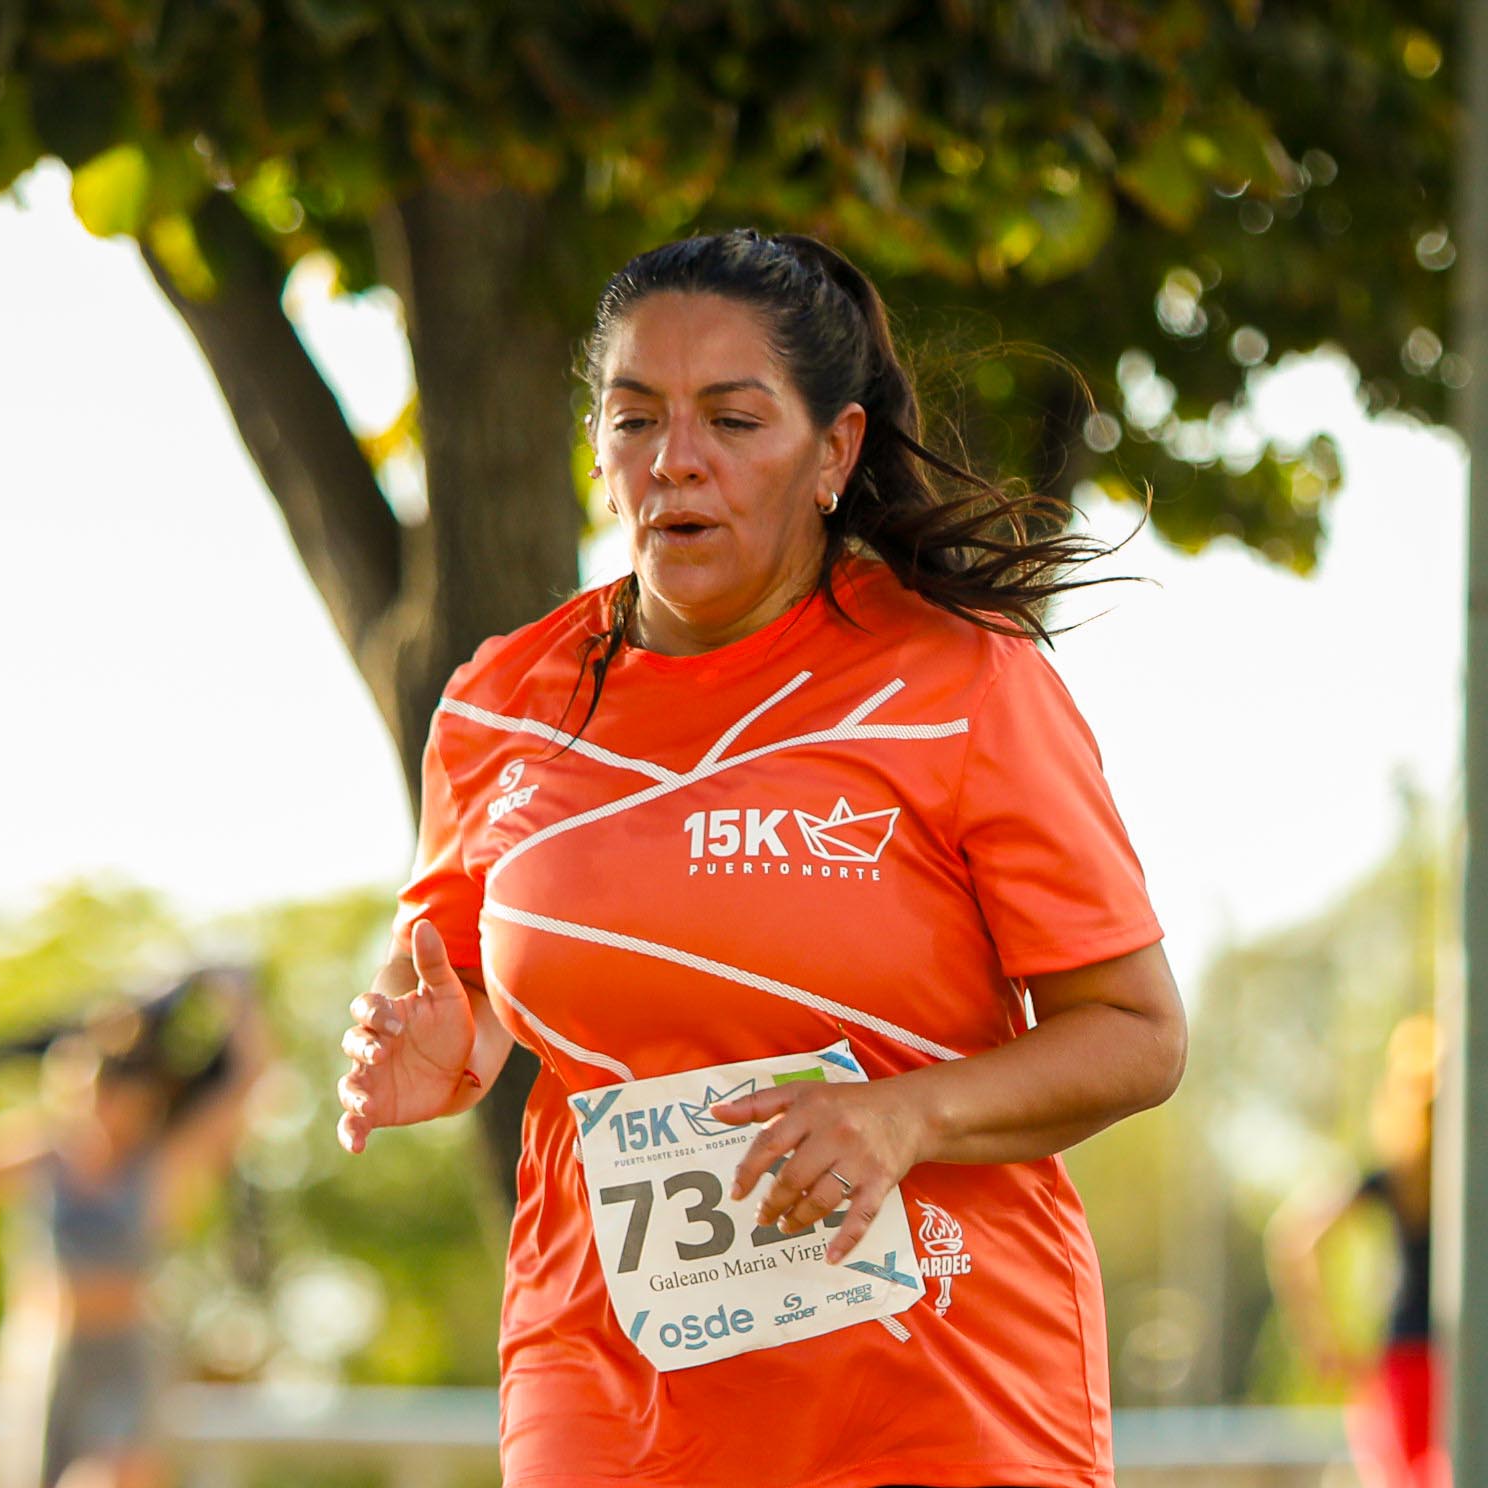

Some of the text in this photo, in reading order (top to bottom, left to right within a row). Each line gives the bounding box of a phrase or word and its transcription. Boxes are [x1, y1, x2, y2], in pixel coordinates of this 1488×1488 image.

[683, 808, 790, 858] 15K
[688, 862, 881, 881] PUERTO NORTE
[609, 1104, 680, 1153] 15K
[614, 1155, 645, 1168] PUERTO
[646, 1150, 673, 1163] NORTE
[705, 1134, 748, 1151] ROSARIO
[599, 1157, 850, 1275] 73
[649, 1237, 828, 1292] Galeano Maria Virgi
[920, 1253, 972, 1277] ARDEC
[826, 1283, 873, 1304] POWER
[659, 1303, 754, 1349] osde
